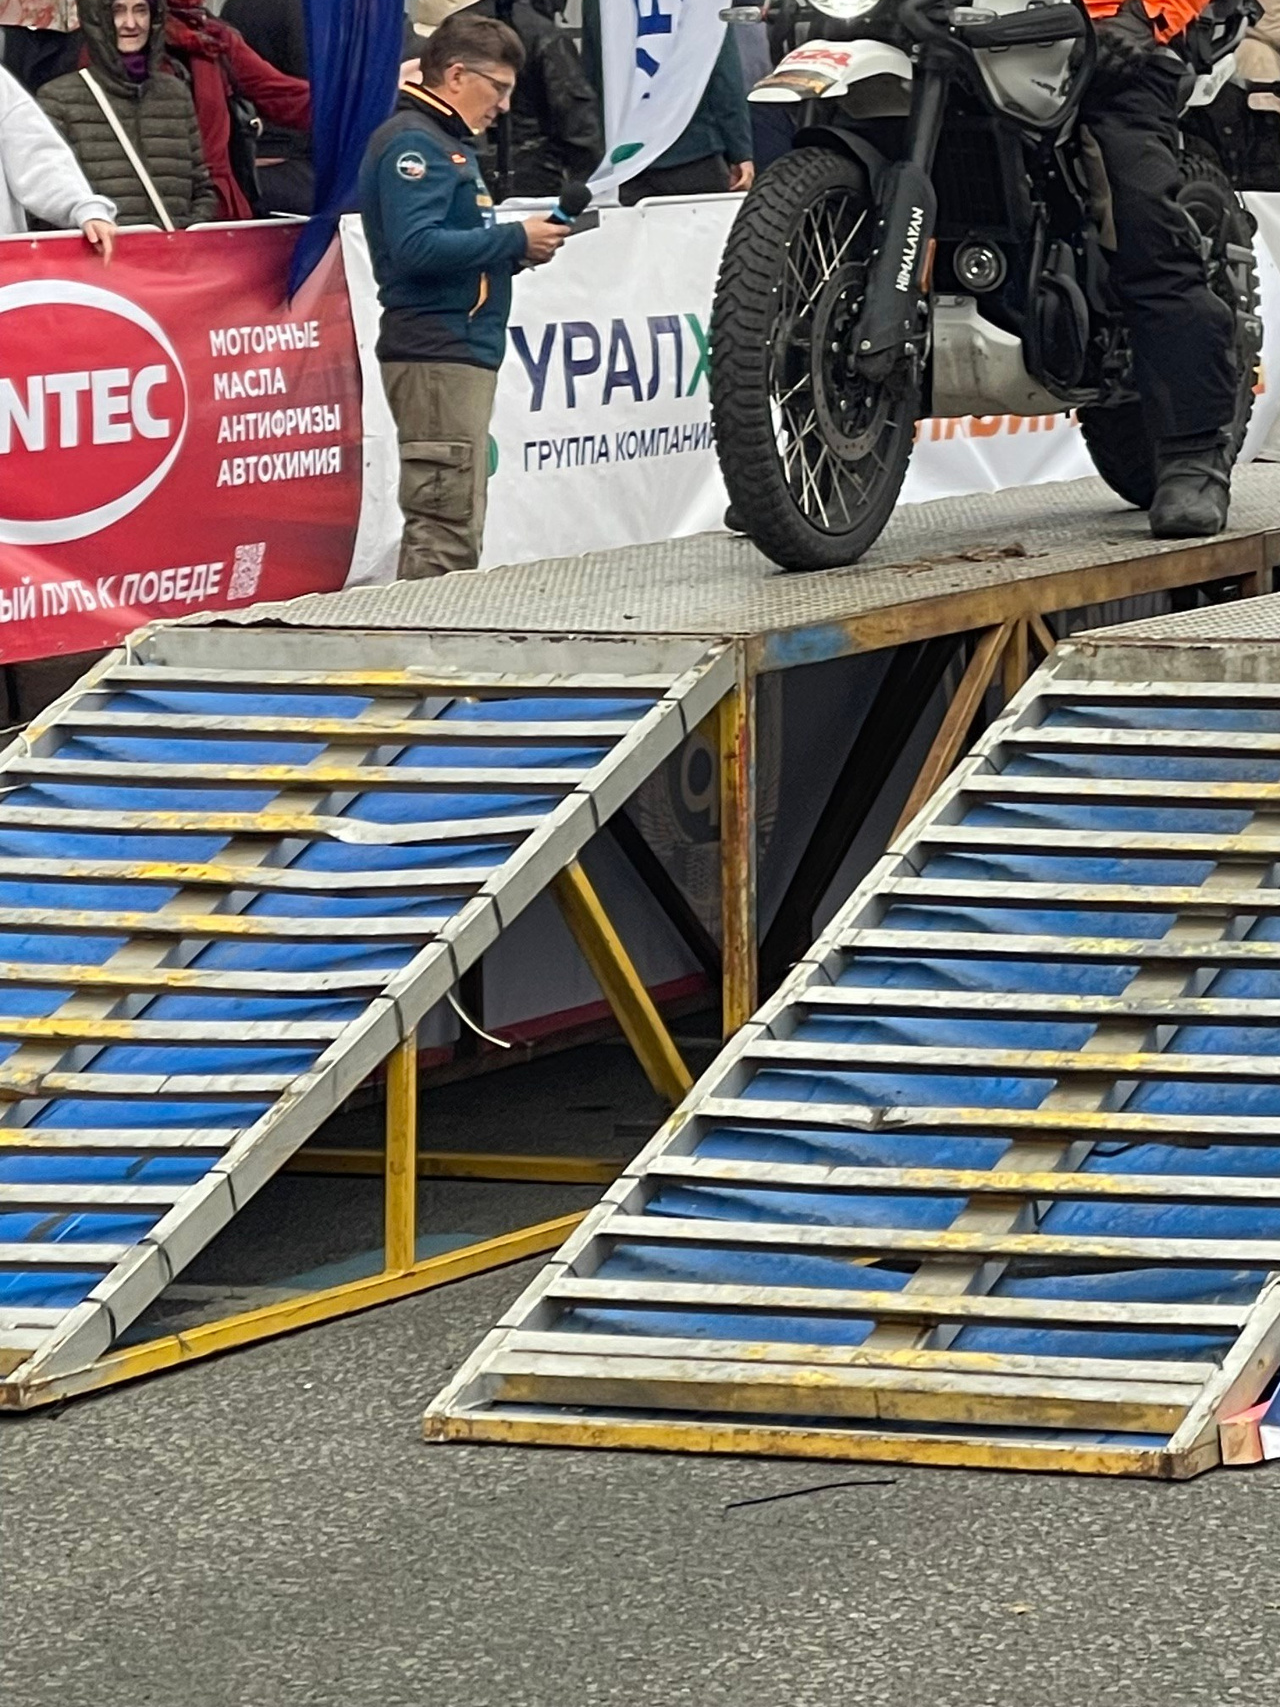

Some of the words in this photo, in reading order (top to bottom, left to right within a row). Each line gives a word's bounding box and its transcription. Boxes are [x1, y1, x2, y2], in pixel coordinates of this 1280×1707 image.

[895, 206, 924, 292] HIMALAYAN
[209, 321, 320, 357] МОТОРНЫЕ
[213, 367, 287, 400] МАСЛА
[216, 404, 341, 444] АНТИФРИЗЫ
[216, 446, 341, 487] АВТОХИМИЯ
[523, 434, 610, 472] ГРУППА
[41, 580, 97, 617] ПУТЬ
[96, 577, 116, 609] К
[119, 562, 225, 606] ПОБЕДЕ
